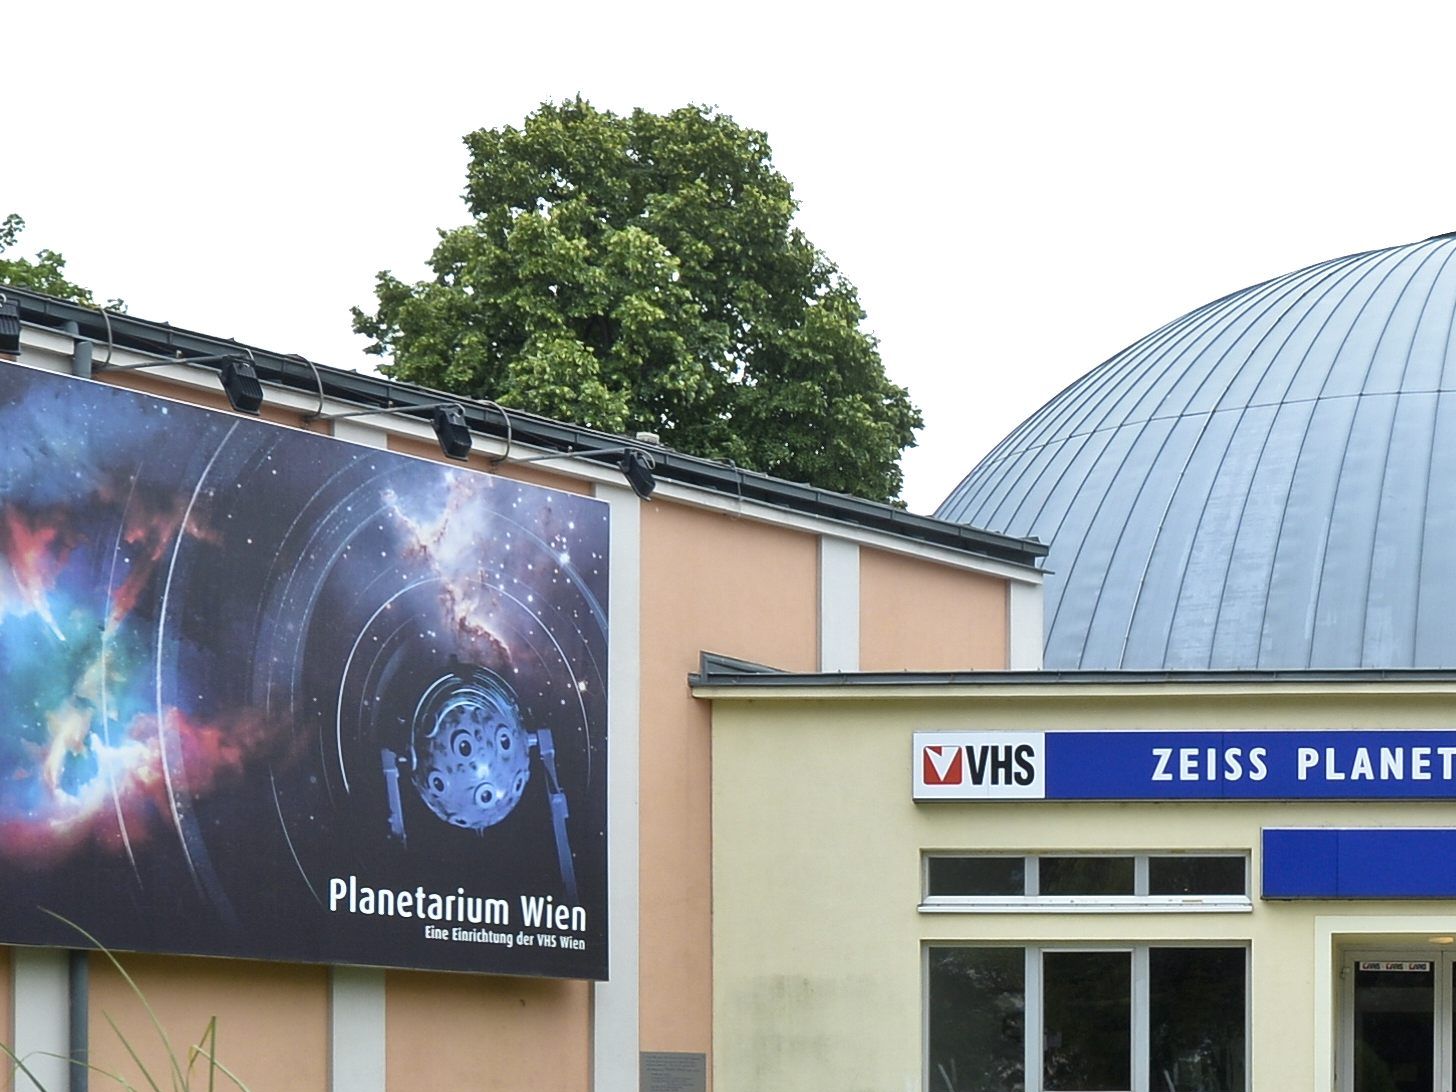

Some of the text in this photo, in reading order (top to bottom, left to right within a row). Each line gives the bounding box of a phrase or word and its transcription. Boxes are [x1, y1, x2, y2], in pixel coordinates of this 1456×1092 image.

[966, 744, 1036, 786] VHS
[1151, 747, 1268, 781] ZEISS
[329, 875, 587, 932] Planetarium Wien
[425, 925, 586, 950] Eine Einrichtung der VHS Wien
